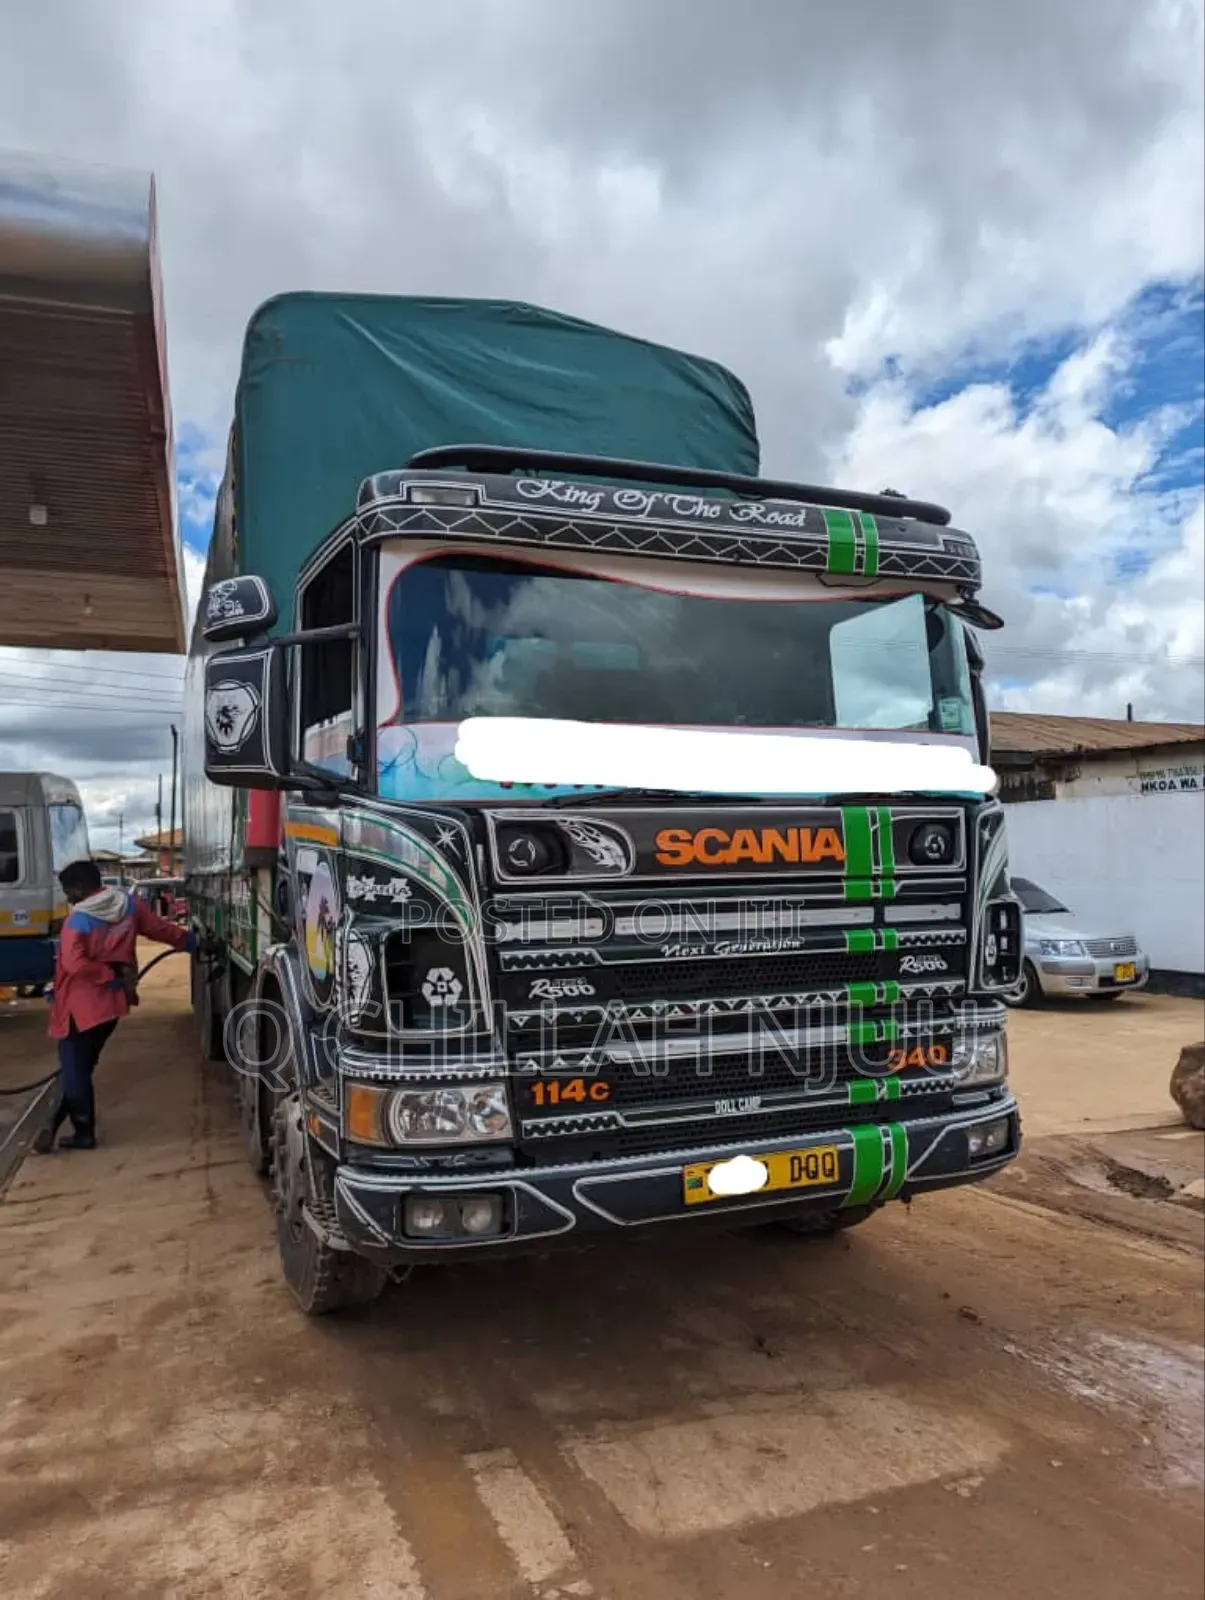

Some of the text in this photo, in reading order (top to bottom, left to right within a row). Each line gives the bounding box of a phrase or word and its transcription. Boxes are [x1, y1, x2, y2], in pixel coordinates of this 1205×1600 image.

[515, 479, 807, 527] King Of The Road
[655, 827, 846, 866] SCANIA
[661, 940, 801, 957] Next Generation
[527, 978, 597, 1000] R500
[887, 1044, 947, 1071] 340
[790, 1152, 835, 1182] DQQ
